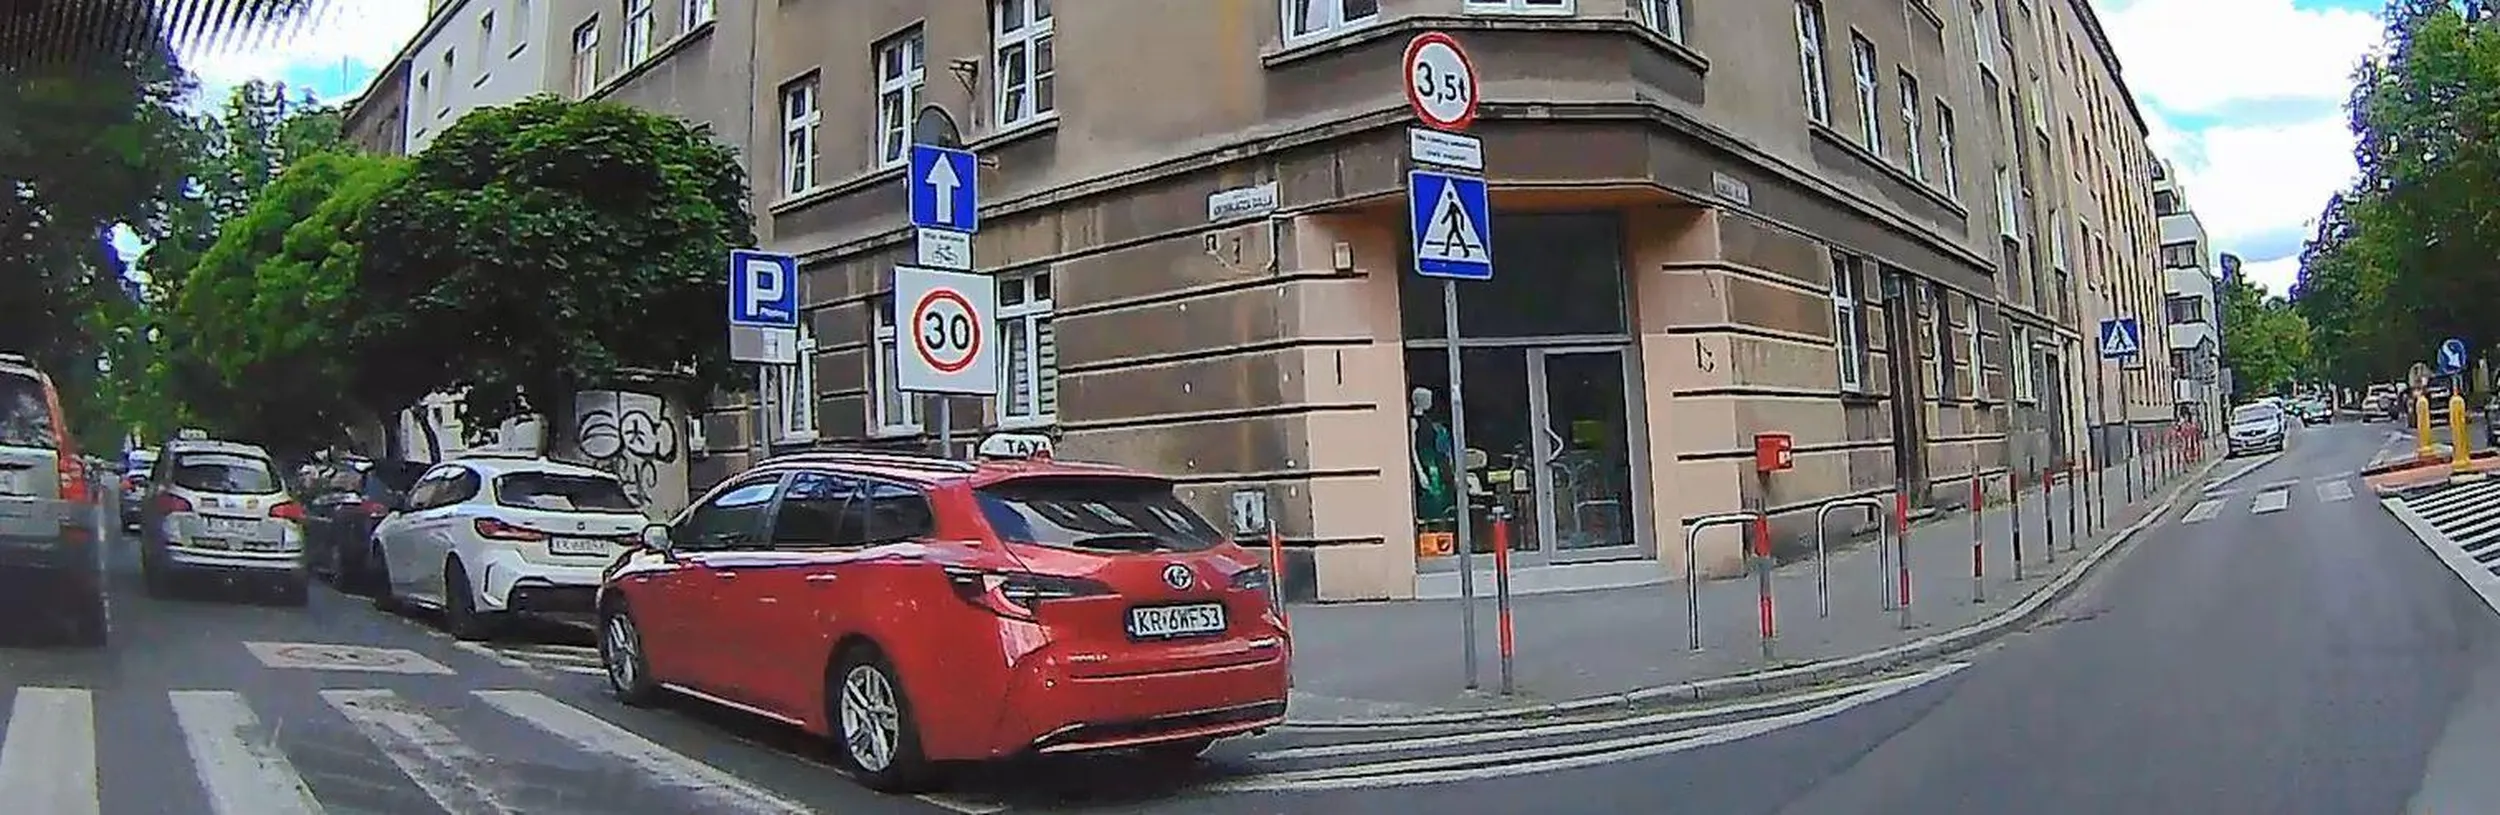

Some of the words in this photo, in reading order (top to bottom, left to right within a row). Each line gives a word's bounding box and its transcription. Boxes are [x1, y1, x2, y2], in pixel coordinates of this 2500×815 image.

[1417, 61, 1467, 104] 3,5t
[746, 259, 783, 316] P
[924, 311, 970, 350] 30
[1138, 611, 1162, 632] KR
